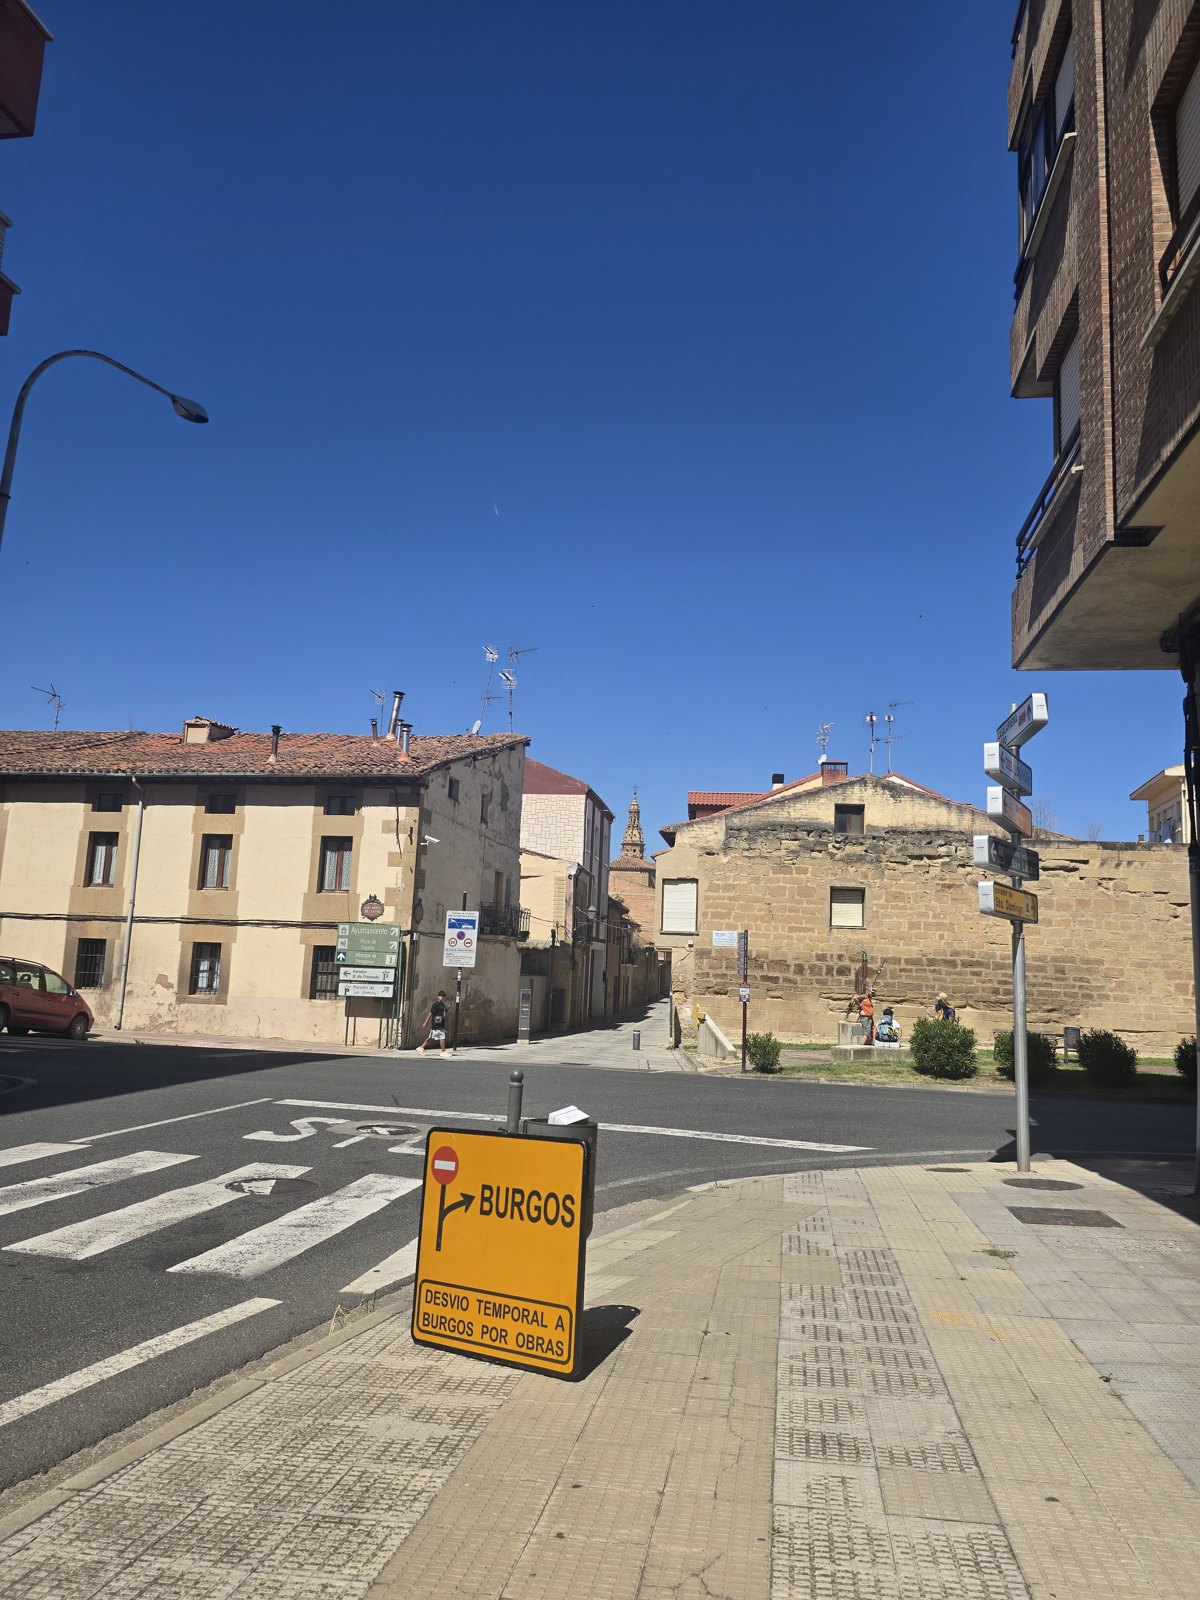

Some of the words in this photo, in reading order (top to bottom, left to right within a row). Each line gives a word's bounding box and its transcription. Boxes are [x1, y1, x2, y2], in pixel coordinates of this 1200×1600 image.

[350, 926, 388, 936] Ayuntamiento
[479, 1183, 576, 1229] BURGOS
[424, 1288, 470, 1312] DESVIO
[476, 1298, 548, 1329] TEMPORAL
[554, 1314, 565, 1332] A
[422, 1311, 474, 1337] BURGOS
[480, 1324, 509, 1345] POR
[515, 1337, 564, 1358] OBRAS
